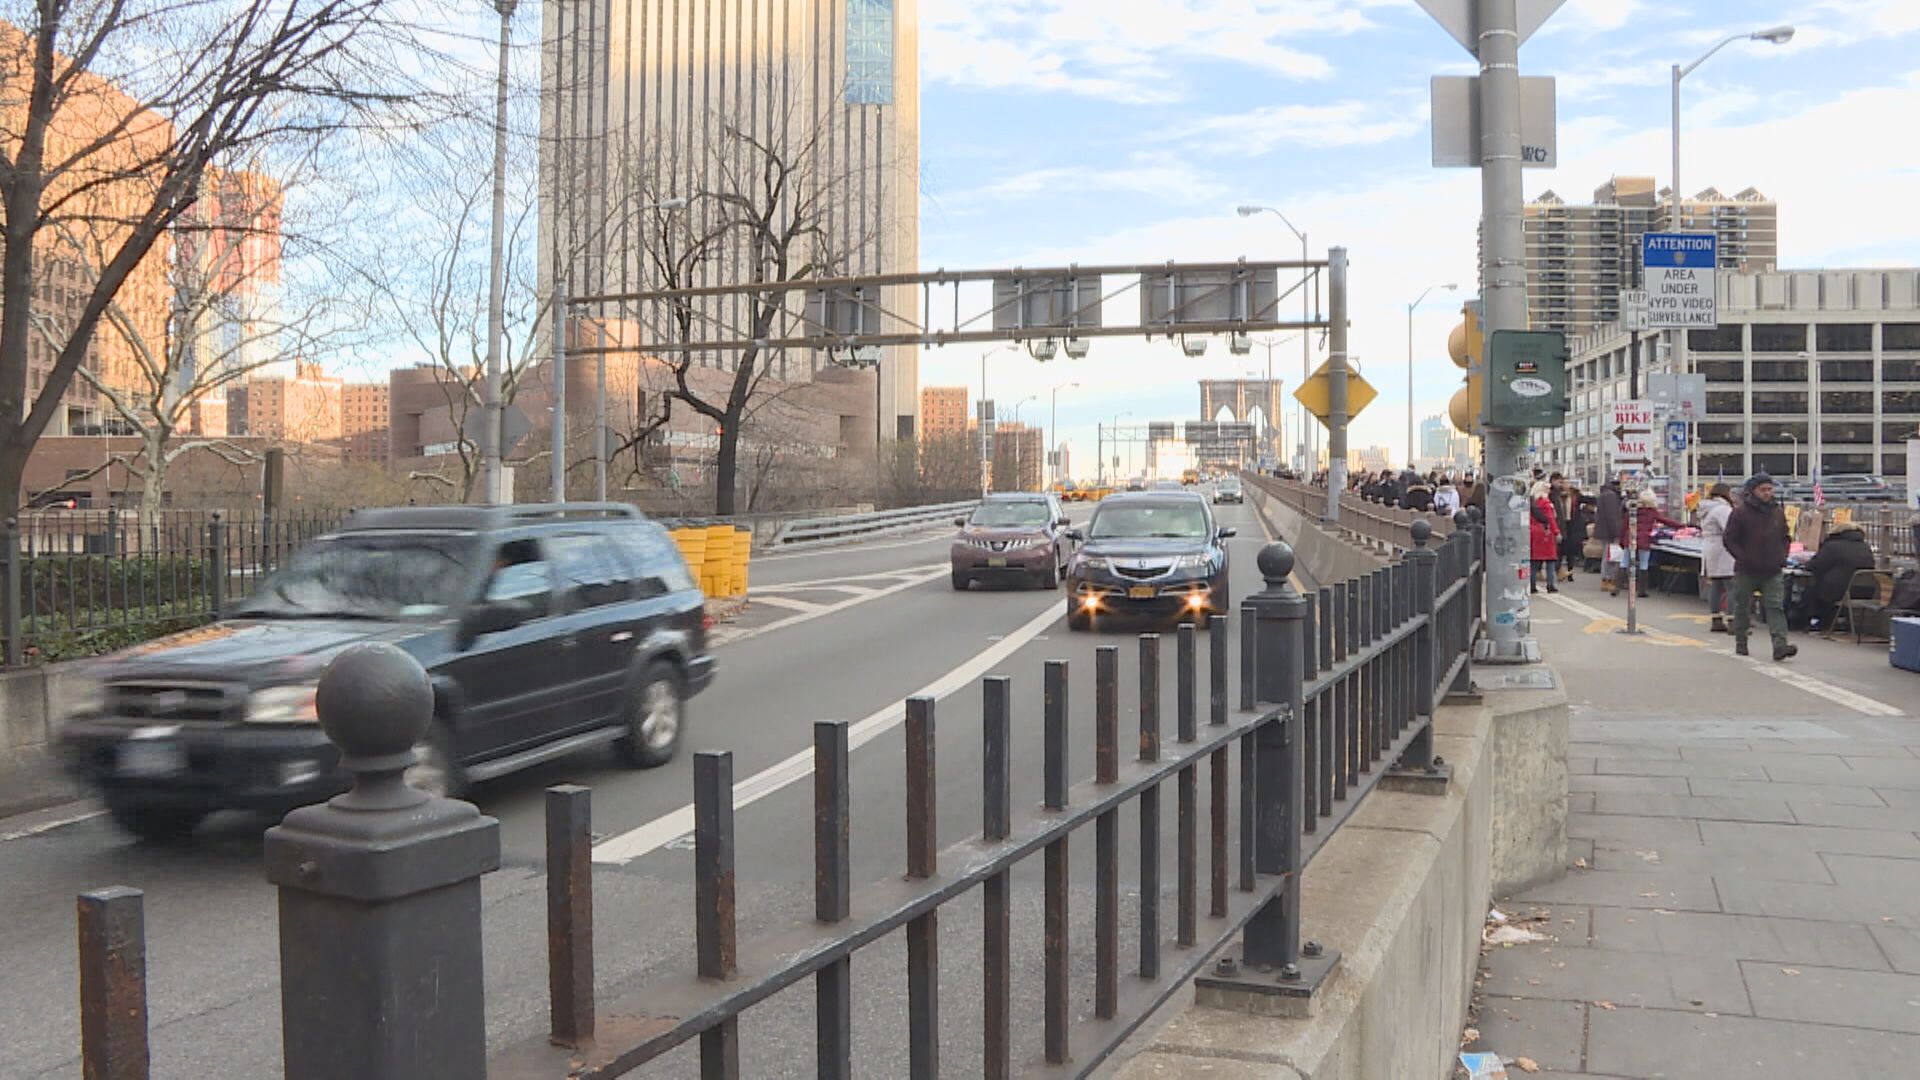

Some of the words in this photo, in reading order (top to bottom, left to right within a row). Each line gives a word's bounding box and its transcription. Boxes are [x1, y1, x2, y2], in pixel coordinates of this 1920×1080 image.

[1647, 238, 1712, 251] ATTENTION
[1663, 268, 1696, 281] AREA
[1660, 282, 1699, 295] UNDER
[1648, 297, 1678, 309] NYPD
[1681, 297, 1714, 310] VIDEO
[1647, 311, 1713, 324] SURVEILLANCE
[1614, 402, 1640, 411] ALERT
[1615, 411, 1651, 424] BIKE
[1617, 442, 1647, 454] WALK
